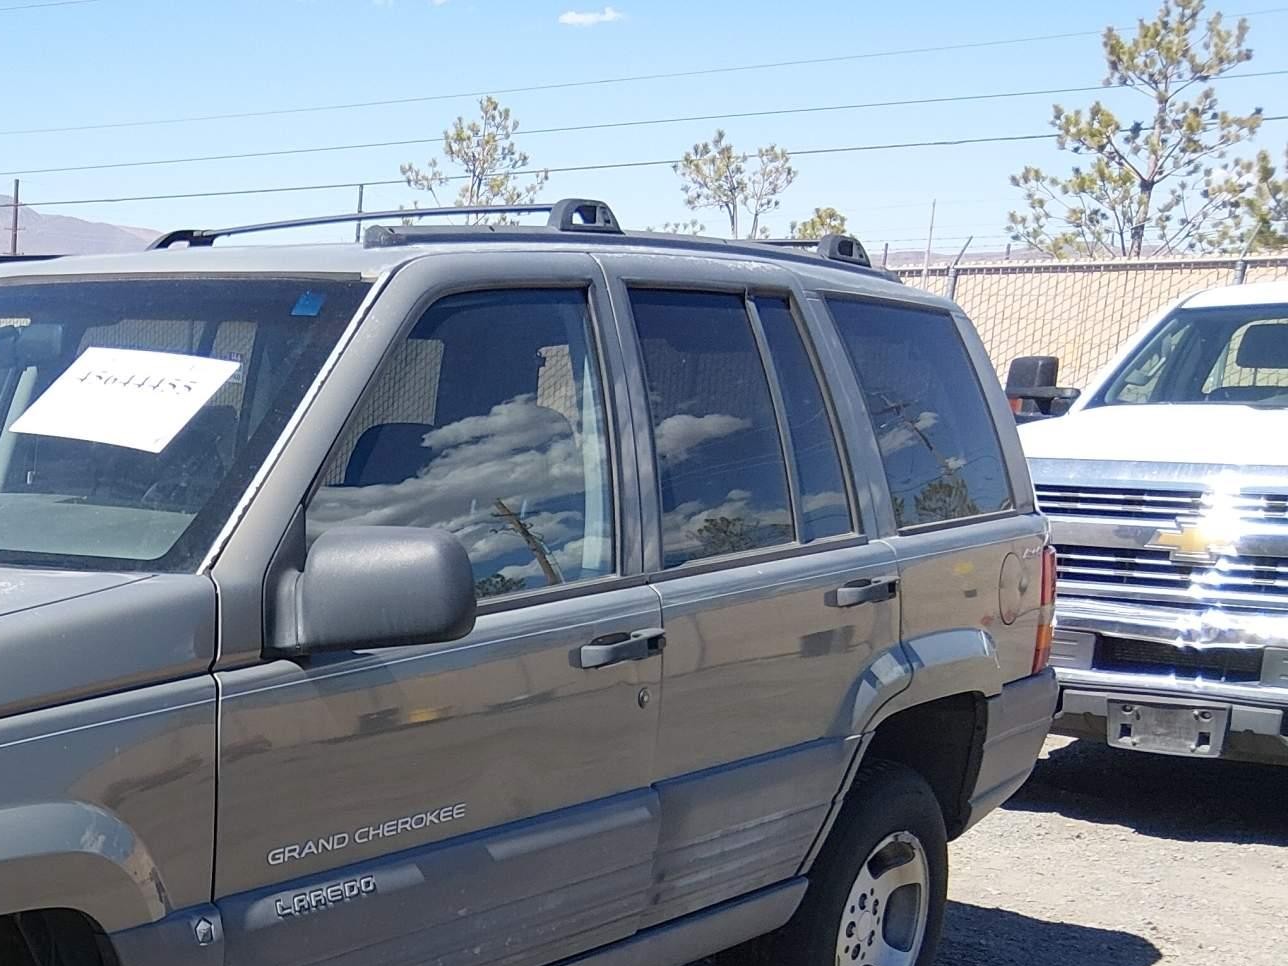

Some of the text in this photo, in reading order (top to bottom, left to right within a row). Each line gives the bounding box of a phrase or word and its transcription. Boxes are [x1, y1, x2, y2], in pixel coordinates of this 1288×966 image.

[267, 803, 467, 866] GRAND CHEROKEE
[274, 874, 377, 919] LAREDO
